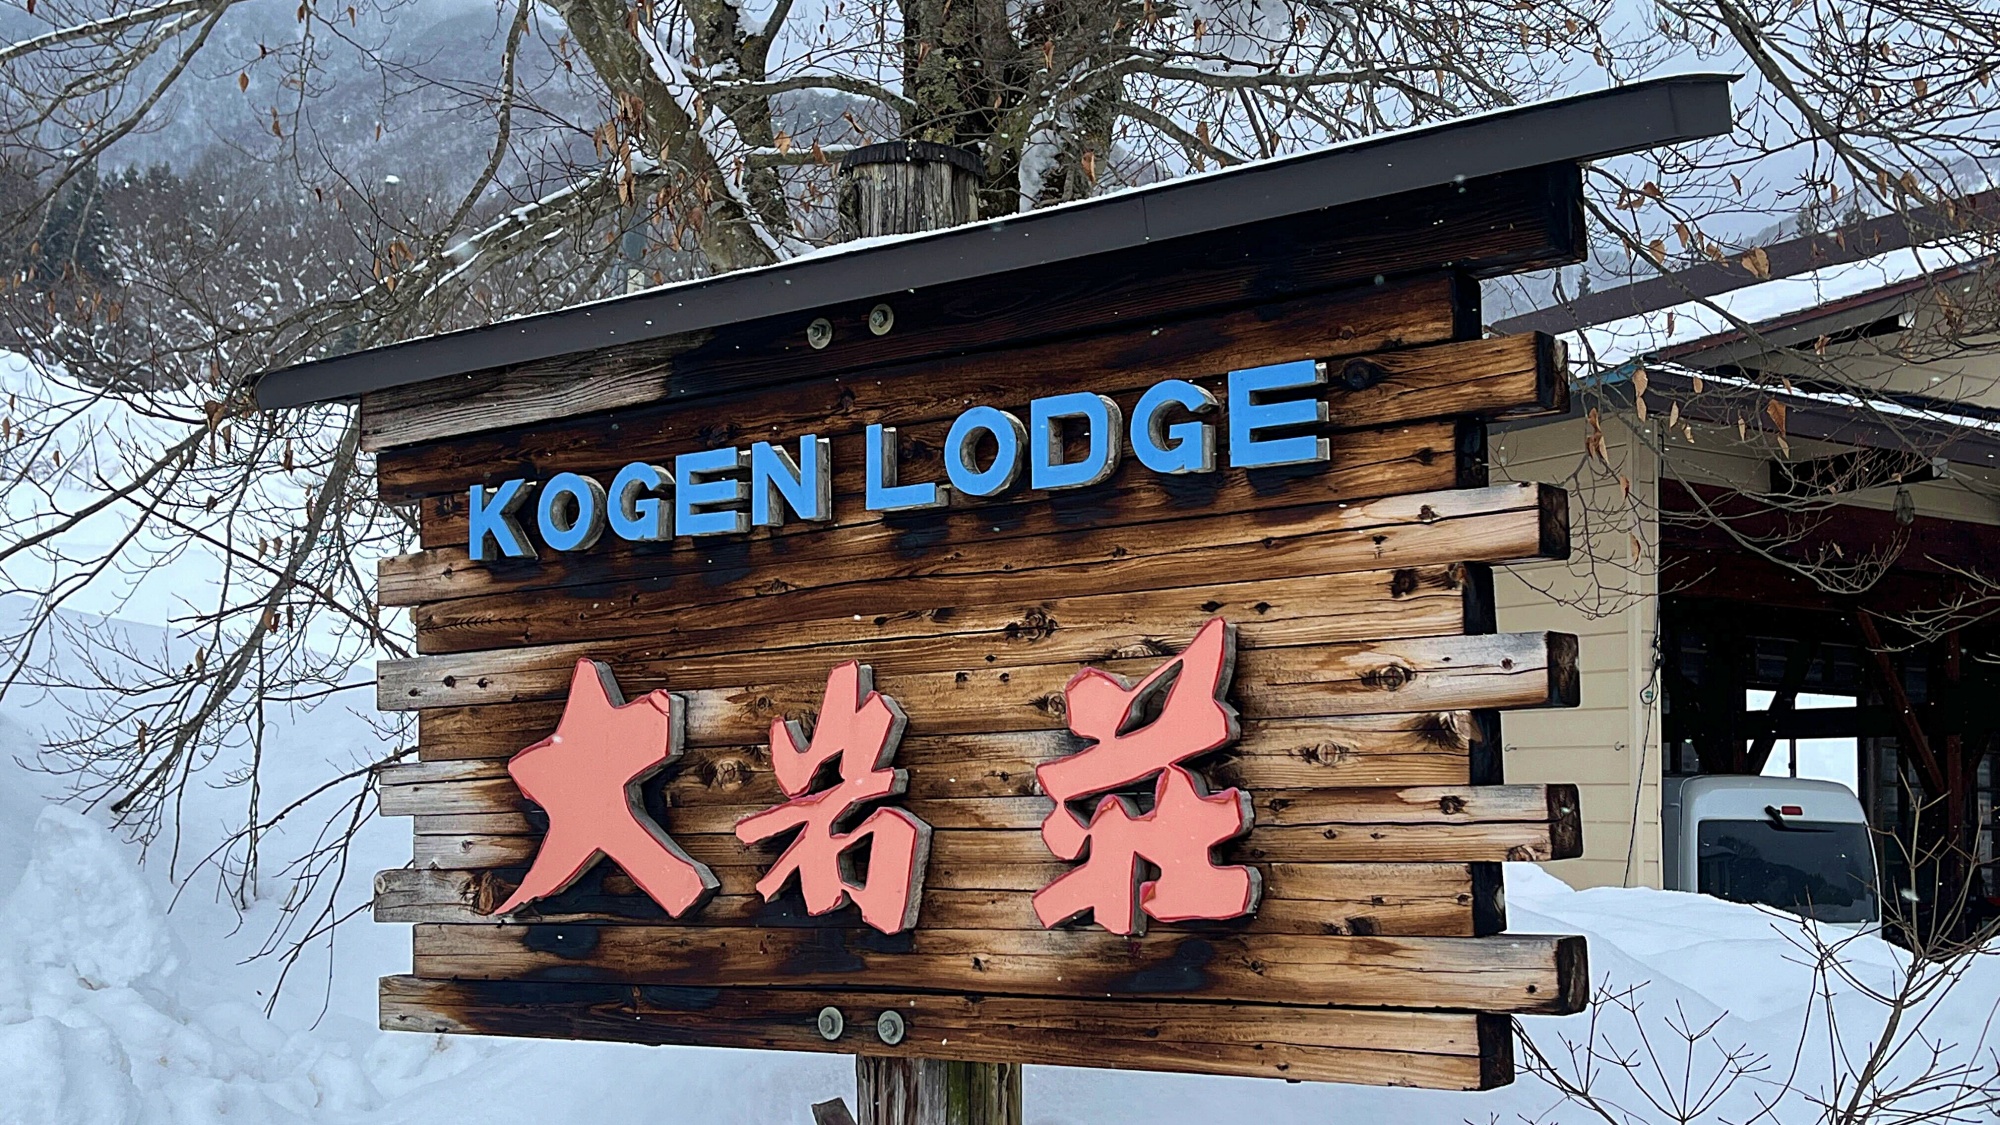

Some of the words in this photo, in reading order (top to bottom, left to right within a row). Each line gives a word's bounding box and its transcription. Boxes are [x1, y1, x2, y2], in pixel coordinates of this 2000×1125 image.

[468, 433, 829, 562] KOGEN
[865, 359, 1327, 511] LODGE
[494, 617, 1256, 936] 大岩荘
